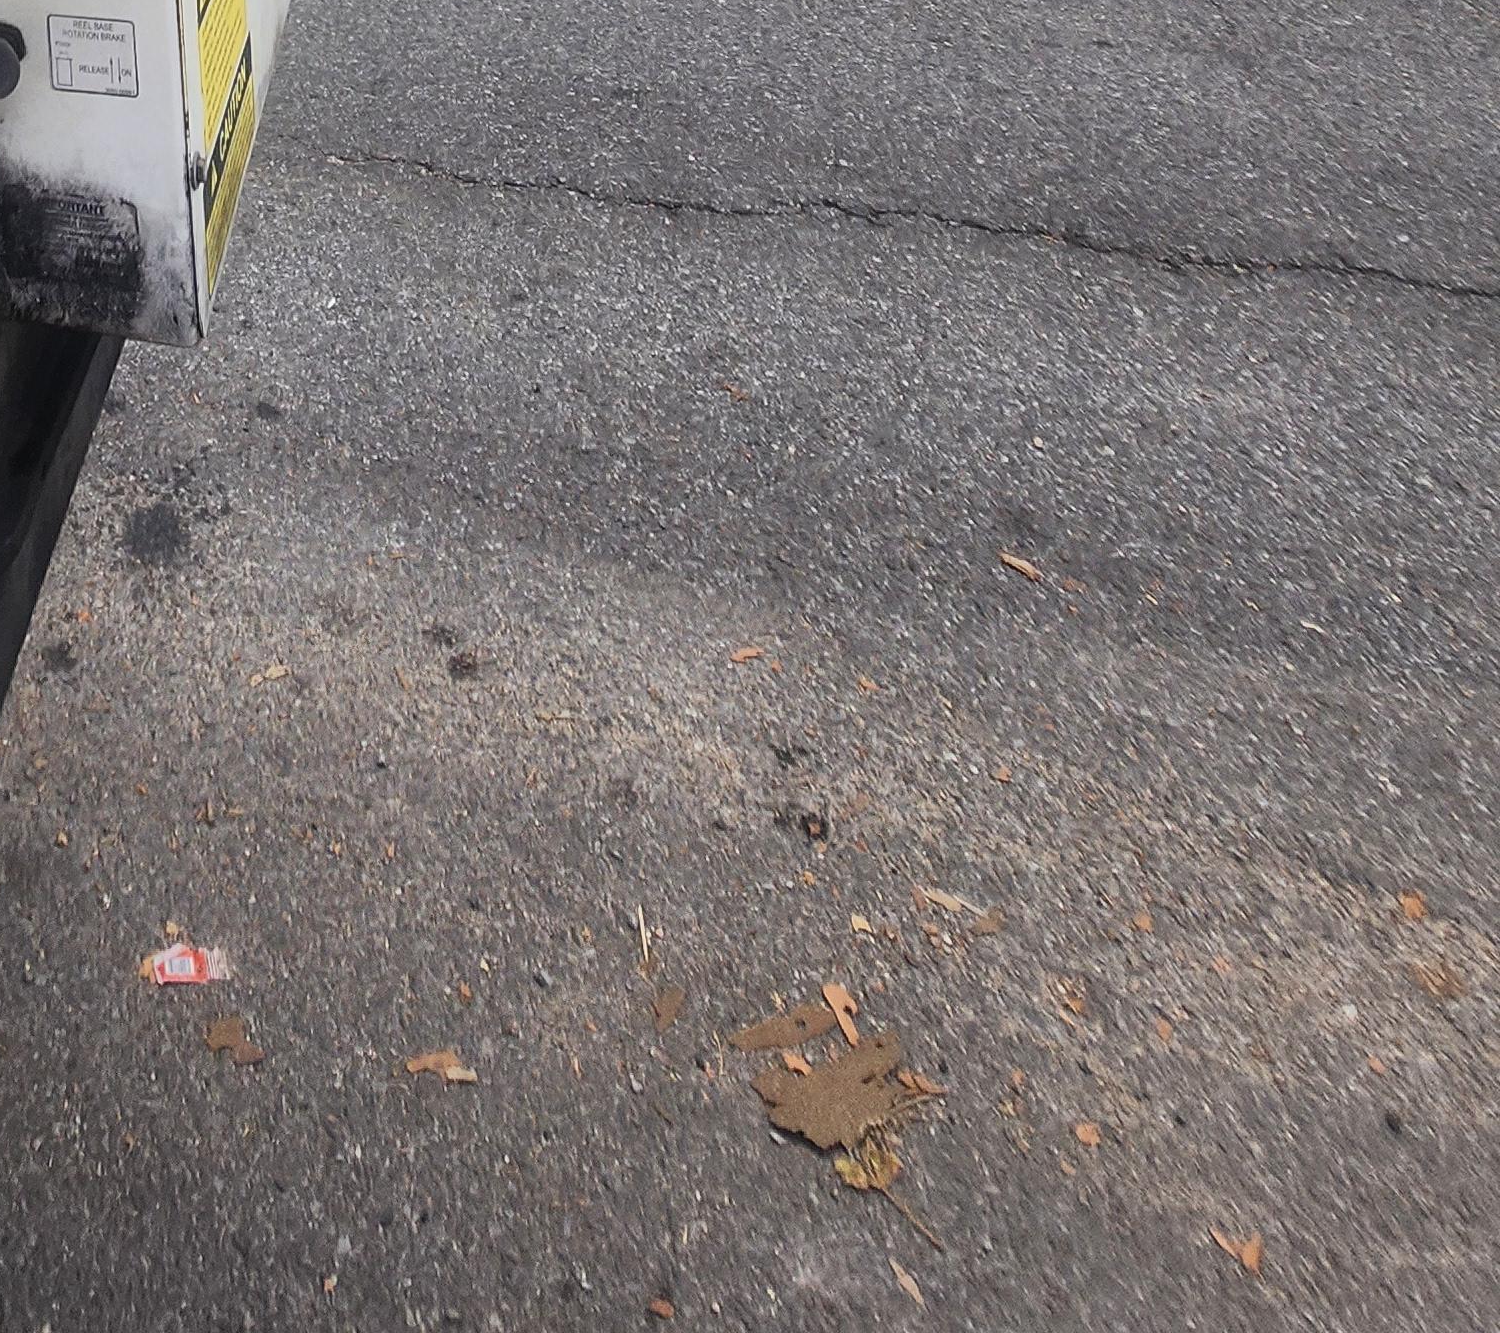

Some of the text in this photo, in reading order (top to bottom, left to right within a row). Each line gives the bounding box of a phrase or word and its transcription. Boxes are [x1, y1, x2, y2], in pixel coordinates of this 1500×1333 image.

[73, 21, 113, 31] REEL BASE
[101, 32, 126, 43] BRAKE
[79, 65, 132, 77] RELEASE ON
